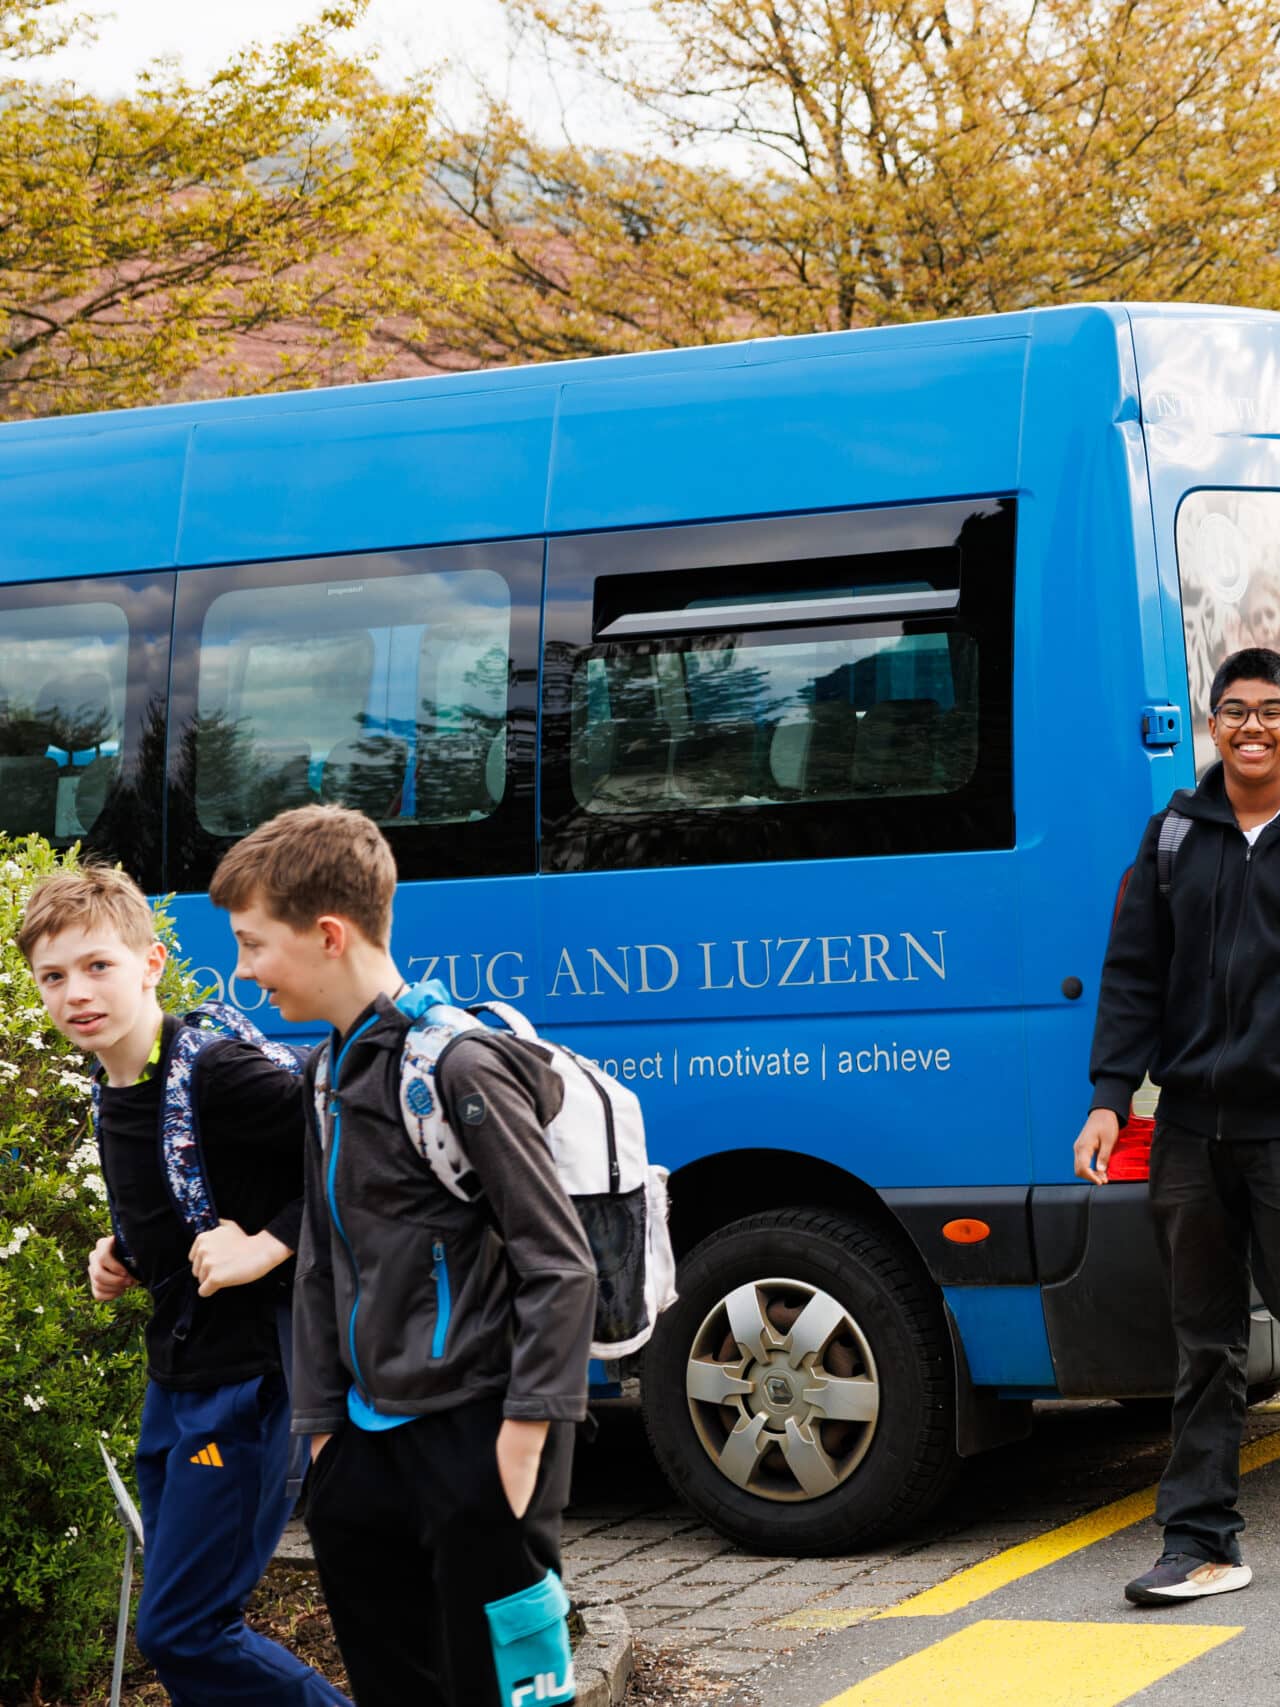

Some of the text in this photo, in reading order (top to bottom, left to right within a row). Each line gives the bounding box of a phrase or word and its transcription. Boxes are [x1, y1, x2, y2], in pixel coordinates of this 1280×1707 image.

[545, 944, 680, 997] AND
[697, 930, 948, 991] LUZERN
[688, 1045, 811, 1078] motivate
[837, 1041, 952, 1074] achieve
